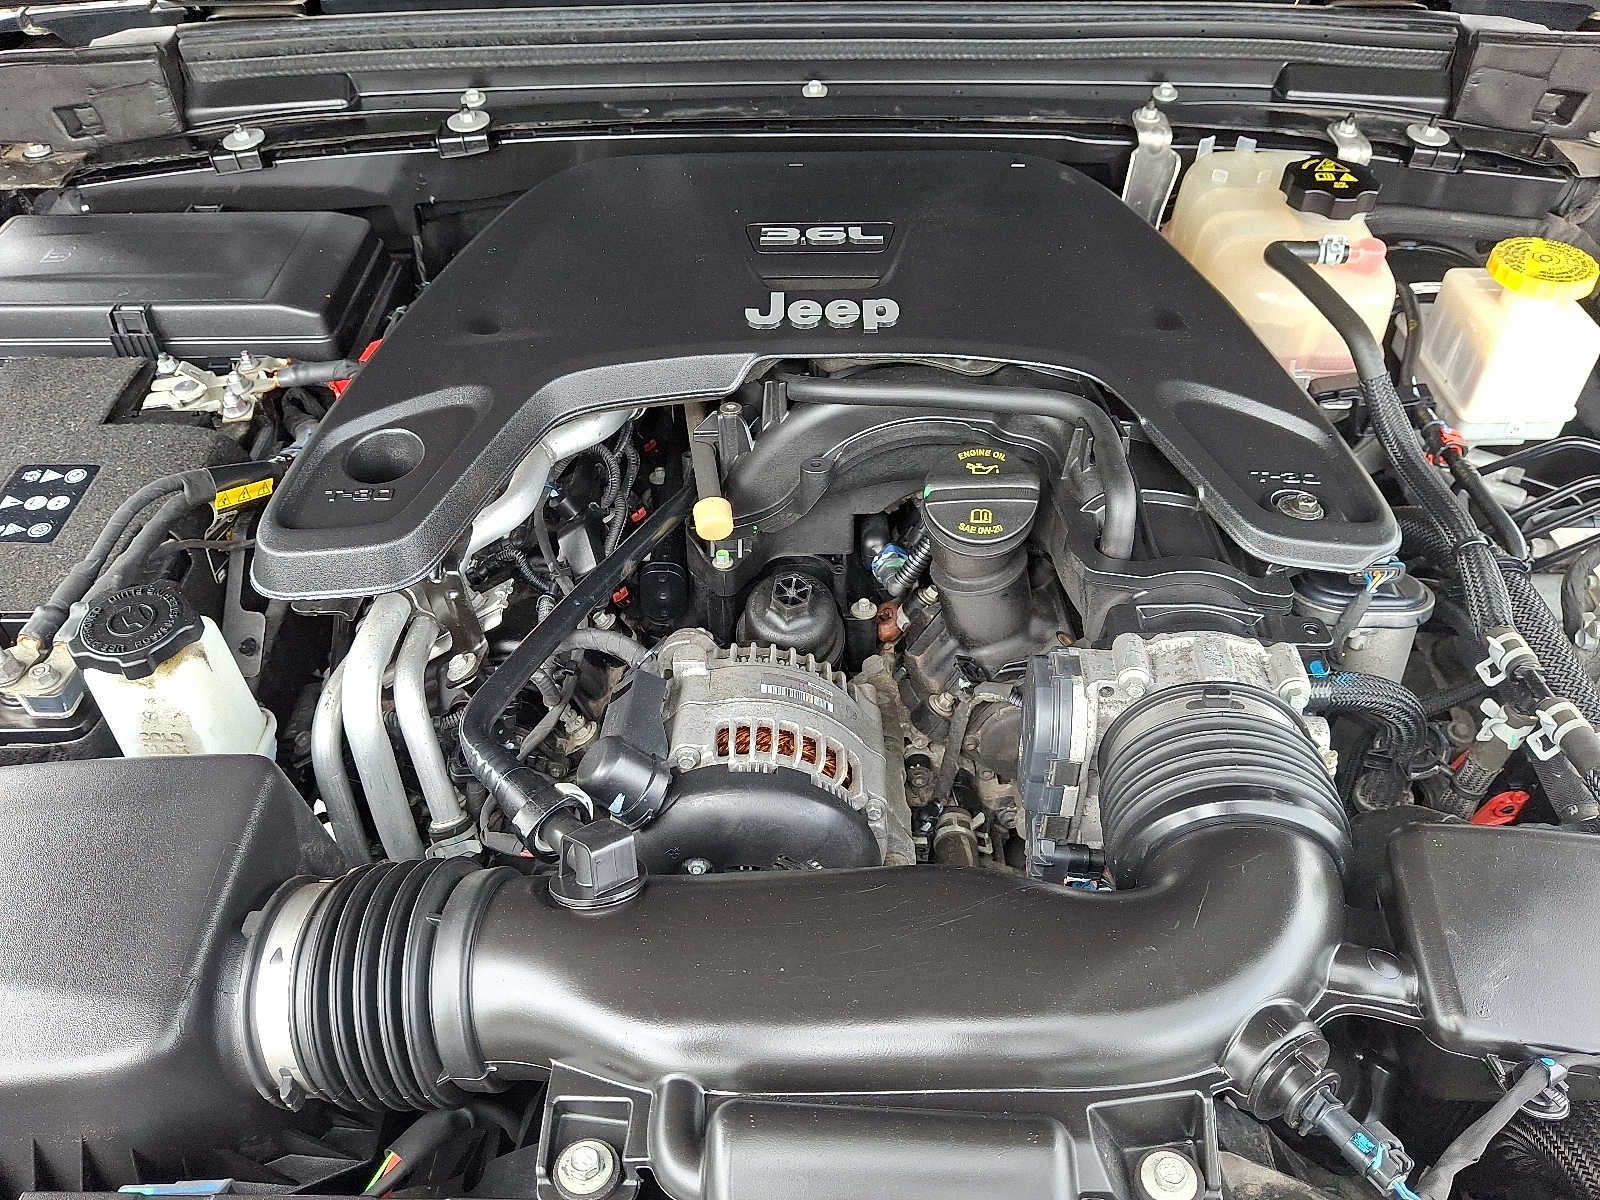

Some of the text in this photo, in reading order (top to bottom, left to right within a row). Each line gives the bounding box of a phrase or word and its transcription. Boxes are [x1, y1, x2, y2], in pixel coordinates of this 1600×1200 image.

[760, 226, 884, 246] 3.6L
[744, 291, 900, 334] Jeep
[957, 448, 1007, 462] ENGINE OIL
[958, 522, 1004, 535] SAE 0W-20
[108, 588, 143, 604] FLUID
[134, 622, 174, 649] POWER
